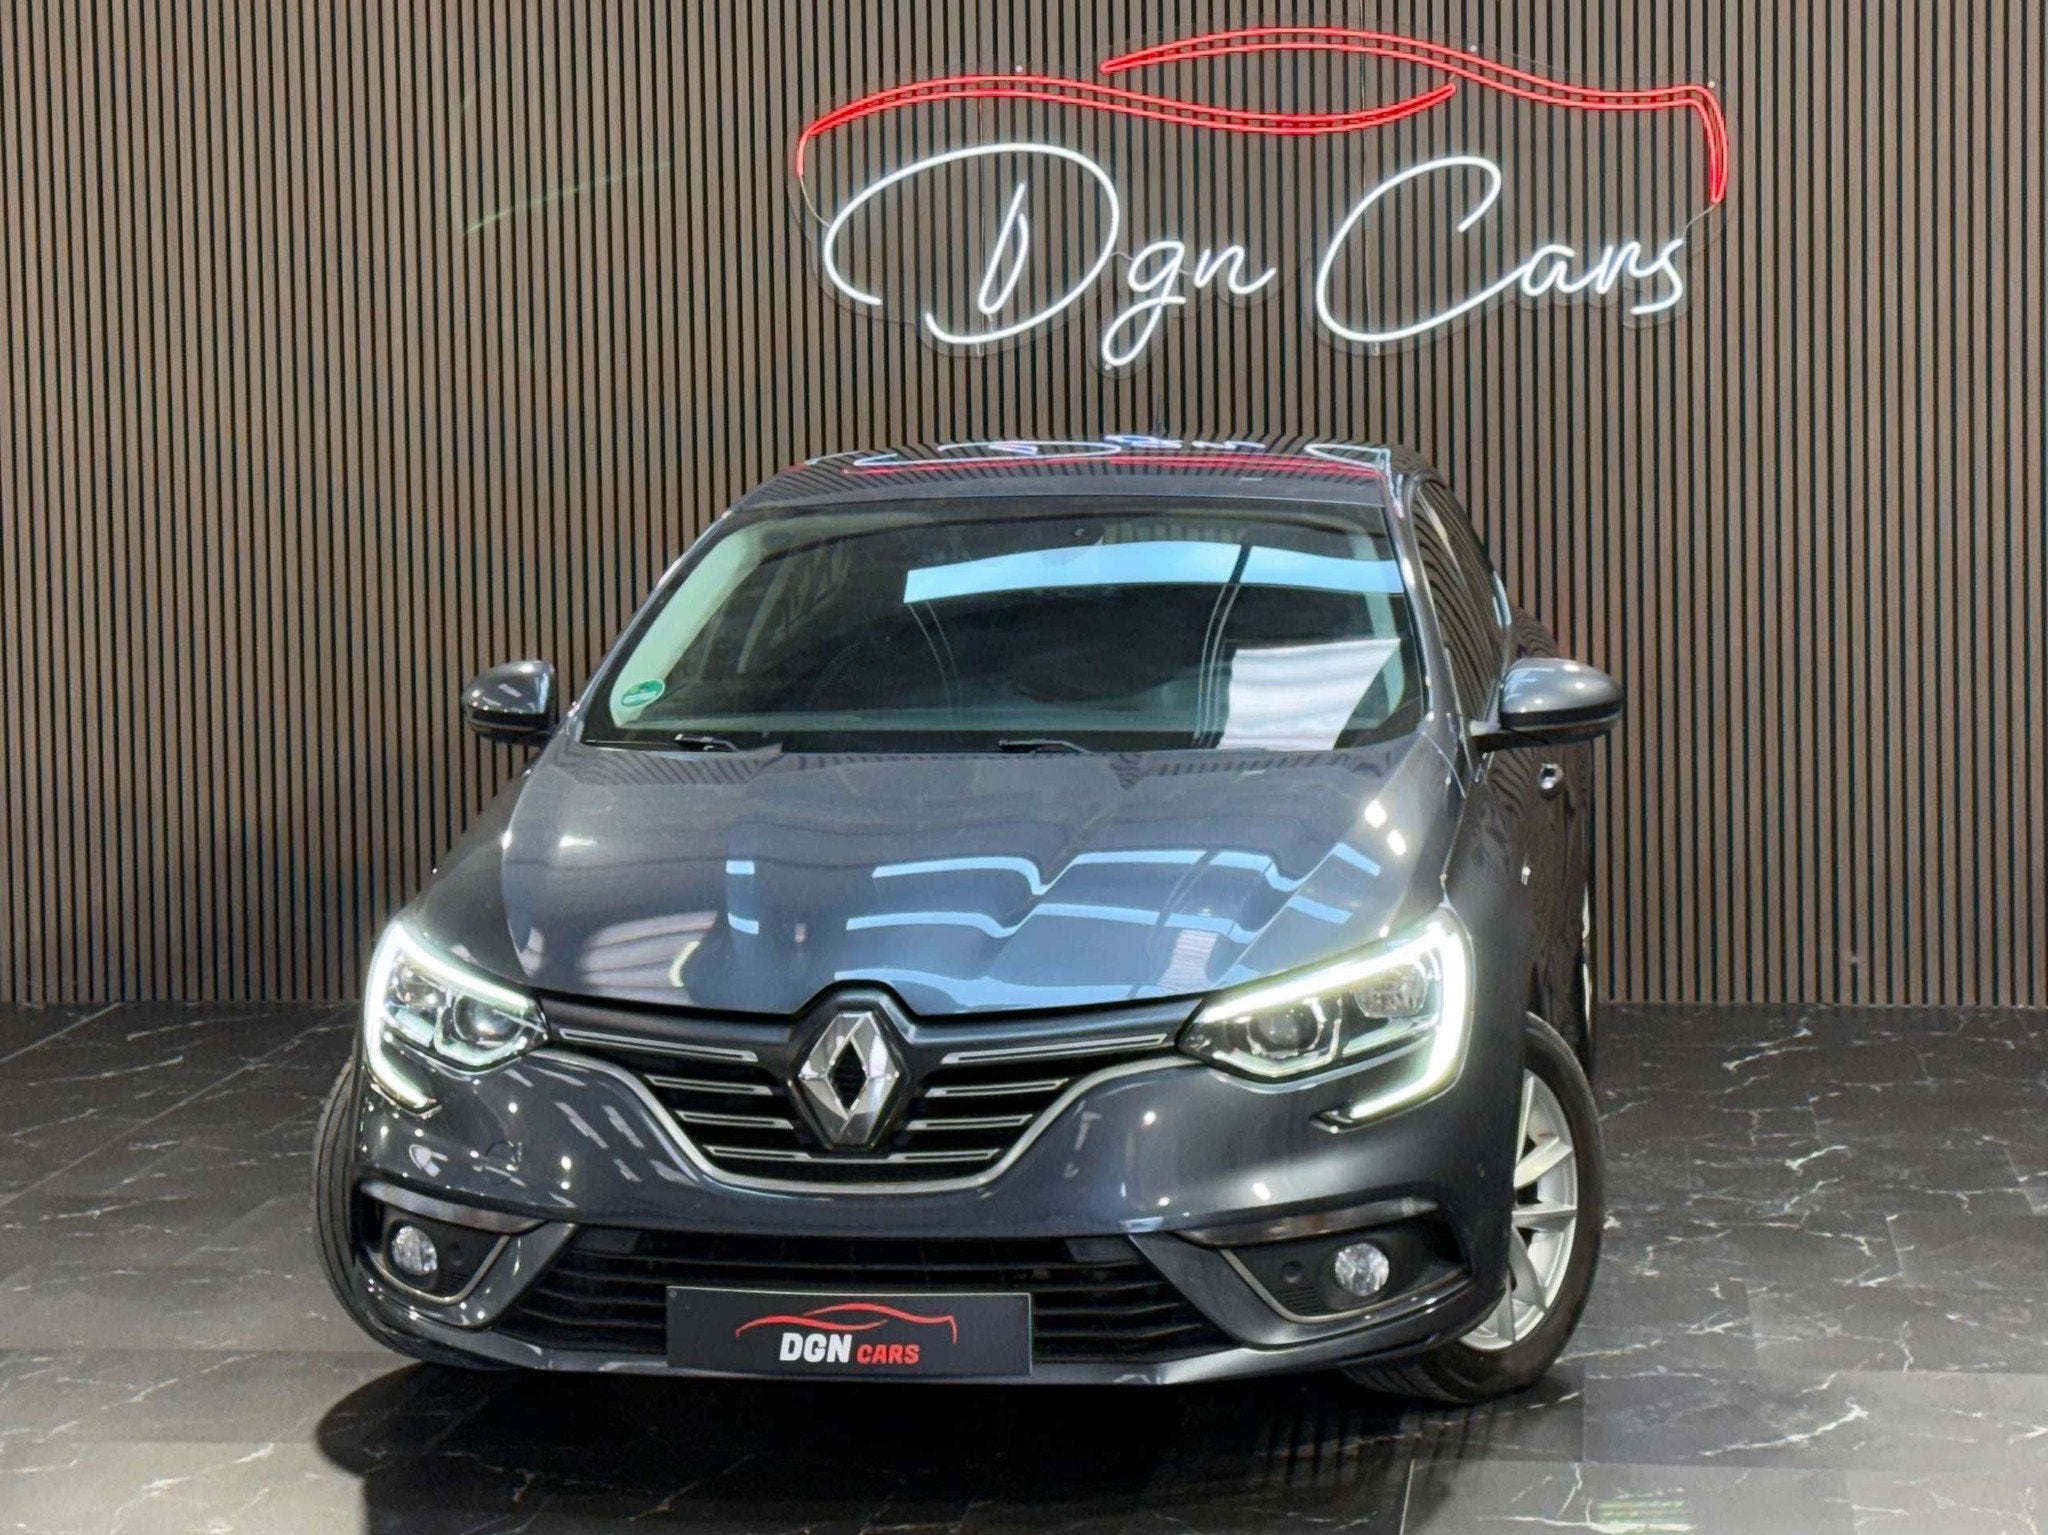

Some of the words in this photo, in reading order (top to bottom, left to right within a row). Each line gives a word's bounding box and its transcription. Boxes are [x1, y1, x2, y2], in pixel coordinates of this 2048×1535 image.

[824, 142, 1276, 366] Dgn
[1316, 156, 1685, 342] Cars
[779, 1332, 853, 1363] DGN
[856, 1343, 920, 1365] CARS
